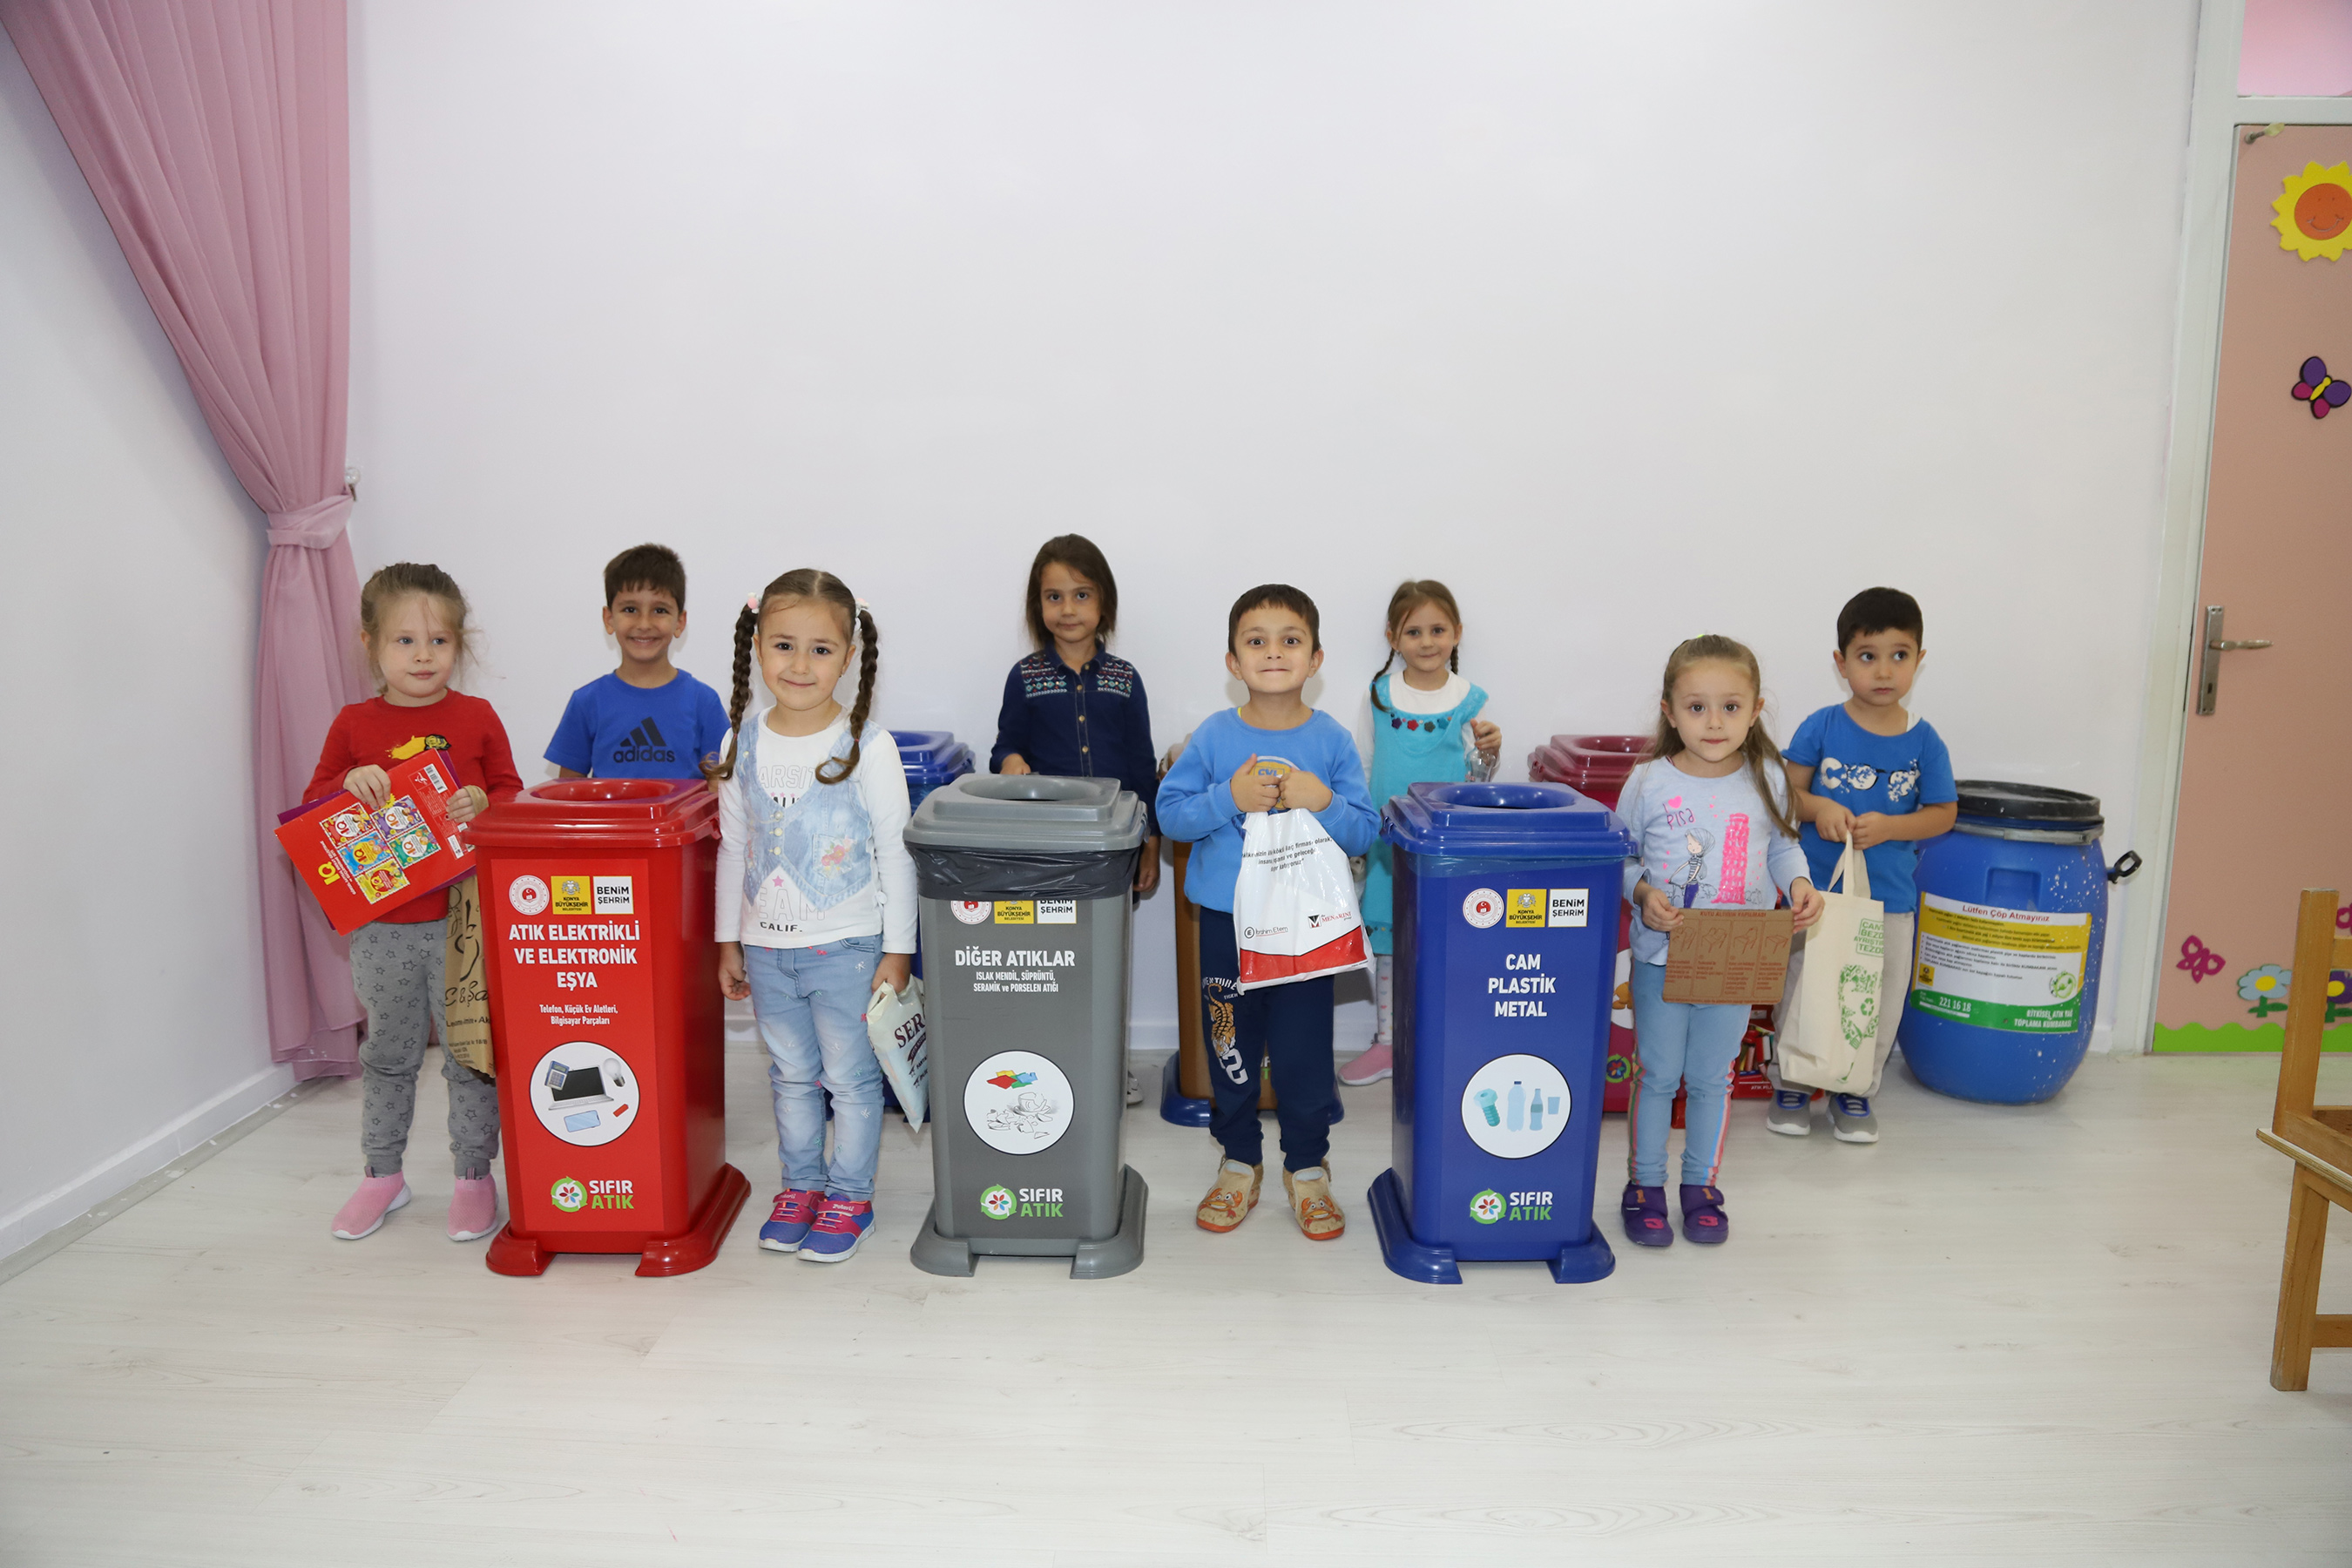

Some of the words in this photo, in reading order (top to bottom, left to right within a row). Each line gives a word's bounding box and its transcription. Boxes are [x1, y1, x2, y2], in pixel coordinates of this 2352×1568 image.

[613, 745, 675, 763] adidas
[318, 862, 340, 885] IQ
[1322, 912, 1351, 923] MENARINI
[1963, 905, 1988, 916] Lütfen
[1990, 909, 2007, 919] Çöp
[509, 924, 545, 941] ATIK
[548, 920, 640, 941] ELEKTRİKLİ
[760, 922, 803, 932] CALIF.
[514, 948, 535, 964] VE
[538, 944, 637, 965] ELEKTRONİK
[955, 946, 1002, 966] DİĞER
[1006, 951, 1075, 966] ATIKLAR
[1506, 954, 1541, 970] CAM
[557, 972, 598, 991] EŞYA
[976, 972, 994, 980] ISLAK
[995, 970, 1020, 981] MENDİL,
[1021, 970, 1055, 981] SÜPRÜNTÜ,
[974, 981, 1000, 992] SERAMİK
[1010, 983, 1041, 992] PORSELEN
[1043, 981, 1058, 992] ATIĞI
[1488, 973, 1556, 994] PLASTİK
[539, 1004, 564, 1014] Telefon,
[564, 1005, 583, 1015] Küçük
[593, 1005, 618, 1014] Aletleri,
[1494, 1001, 1548, 1017] METAL
[1939, 997, 1951, 1008] 221
[1953, 1000, 1962, 1010] 16
[1963, 1002, 1972, 1012] 18
[551, 1017, 581, 1027] Bilgisayar
[582, 1017, 610, 1027] Parçaları
[2014, 1018, 2041, 1027] TOPLAMA
[589, 1180, 633, 1194] SIFIR
[591, 1195, 634, 1210] ATIK
[1019, 1188, 1063, 1202] SIFIR
[1509, 1191, 1553, 1206] SIFIR
[1021, 1203, 1063, 1217] ATIK
[1509, 1206, 1552, 1221] ATIK
